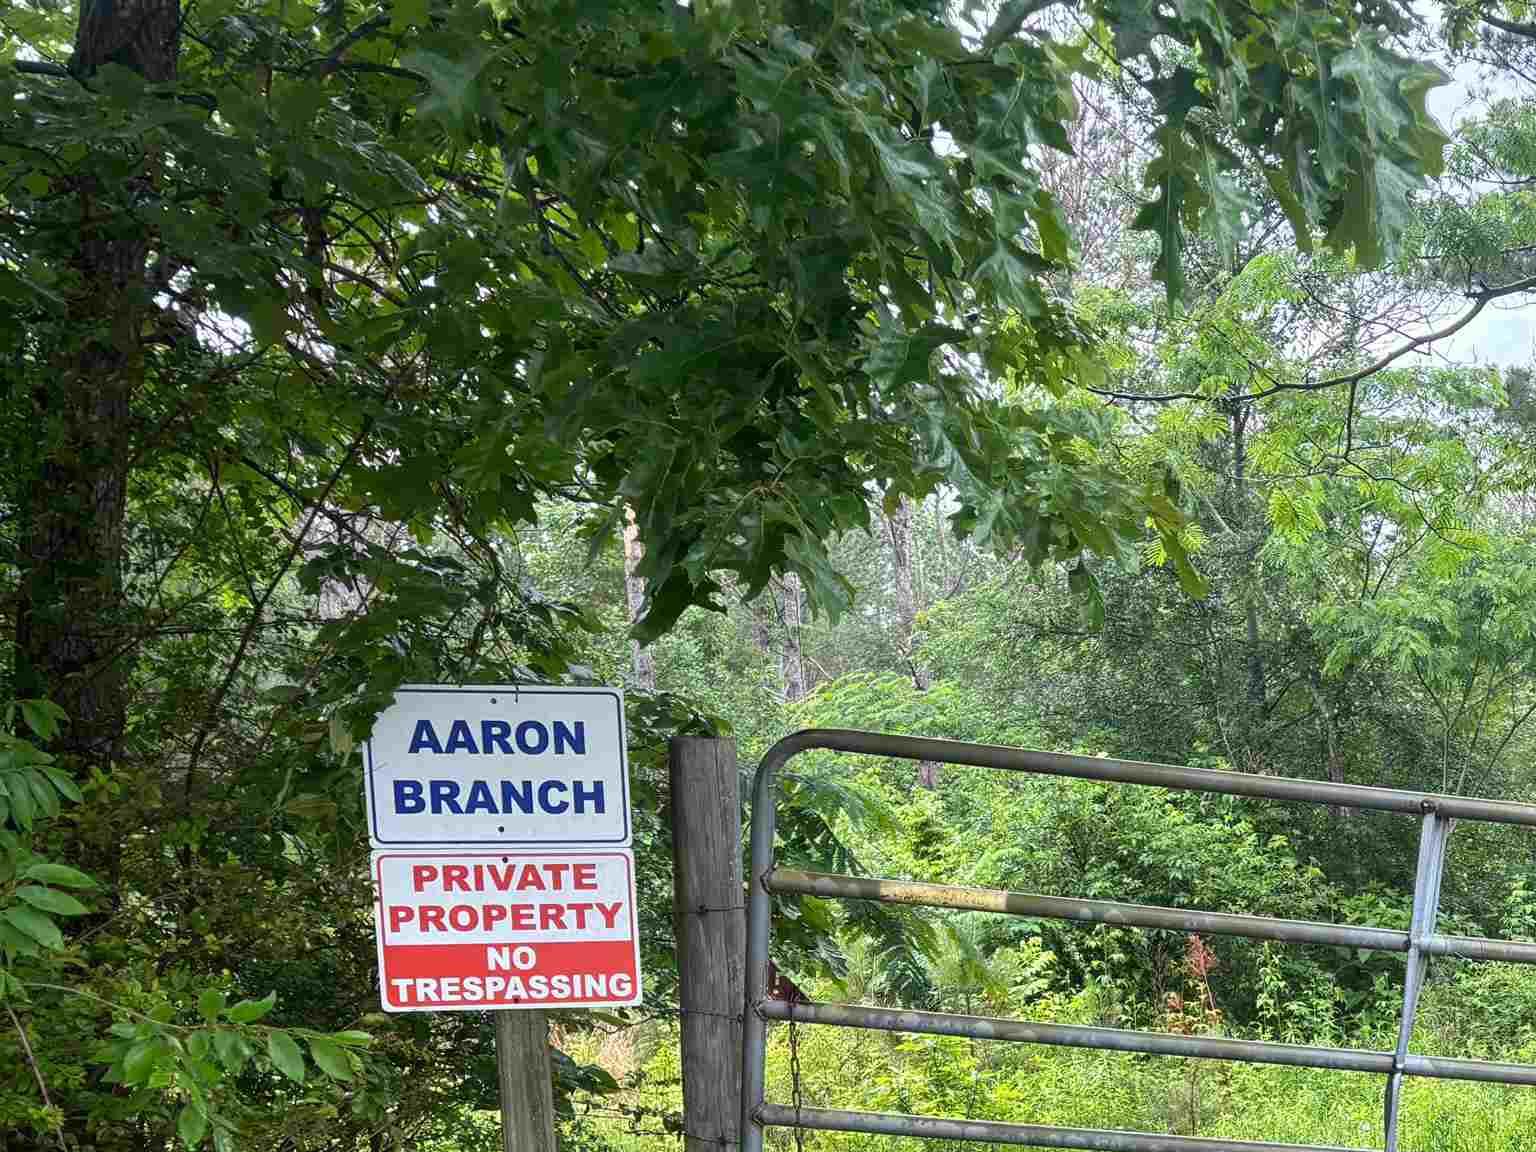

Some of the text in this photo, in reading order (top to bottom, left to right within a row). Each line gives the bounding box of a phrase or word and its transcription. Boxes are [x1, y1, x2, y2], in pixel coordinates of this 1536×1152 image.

[408, 719, 586, 755] AARON
[392, 780, 606, 815] BRANCH
[411, 863, 598, 893] PRIVATE
[388, 902, 623, 933] PROPERTY
[486, 946, 537, 971] NO
[391, 973, 632, 1003] TRESPASSING
